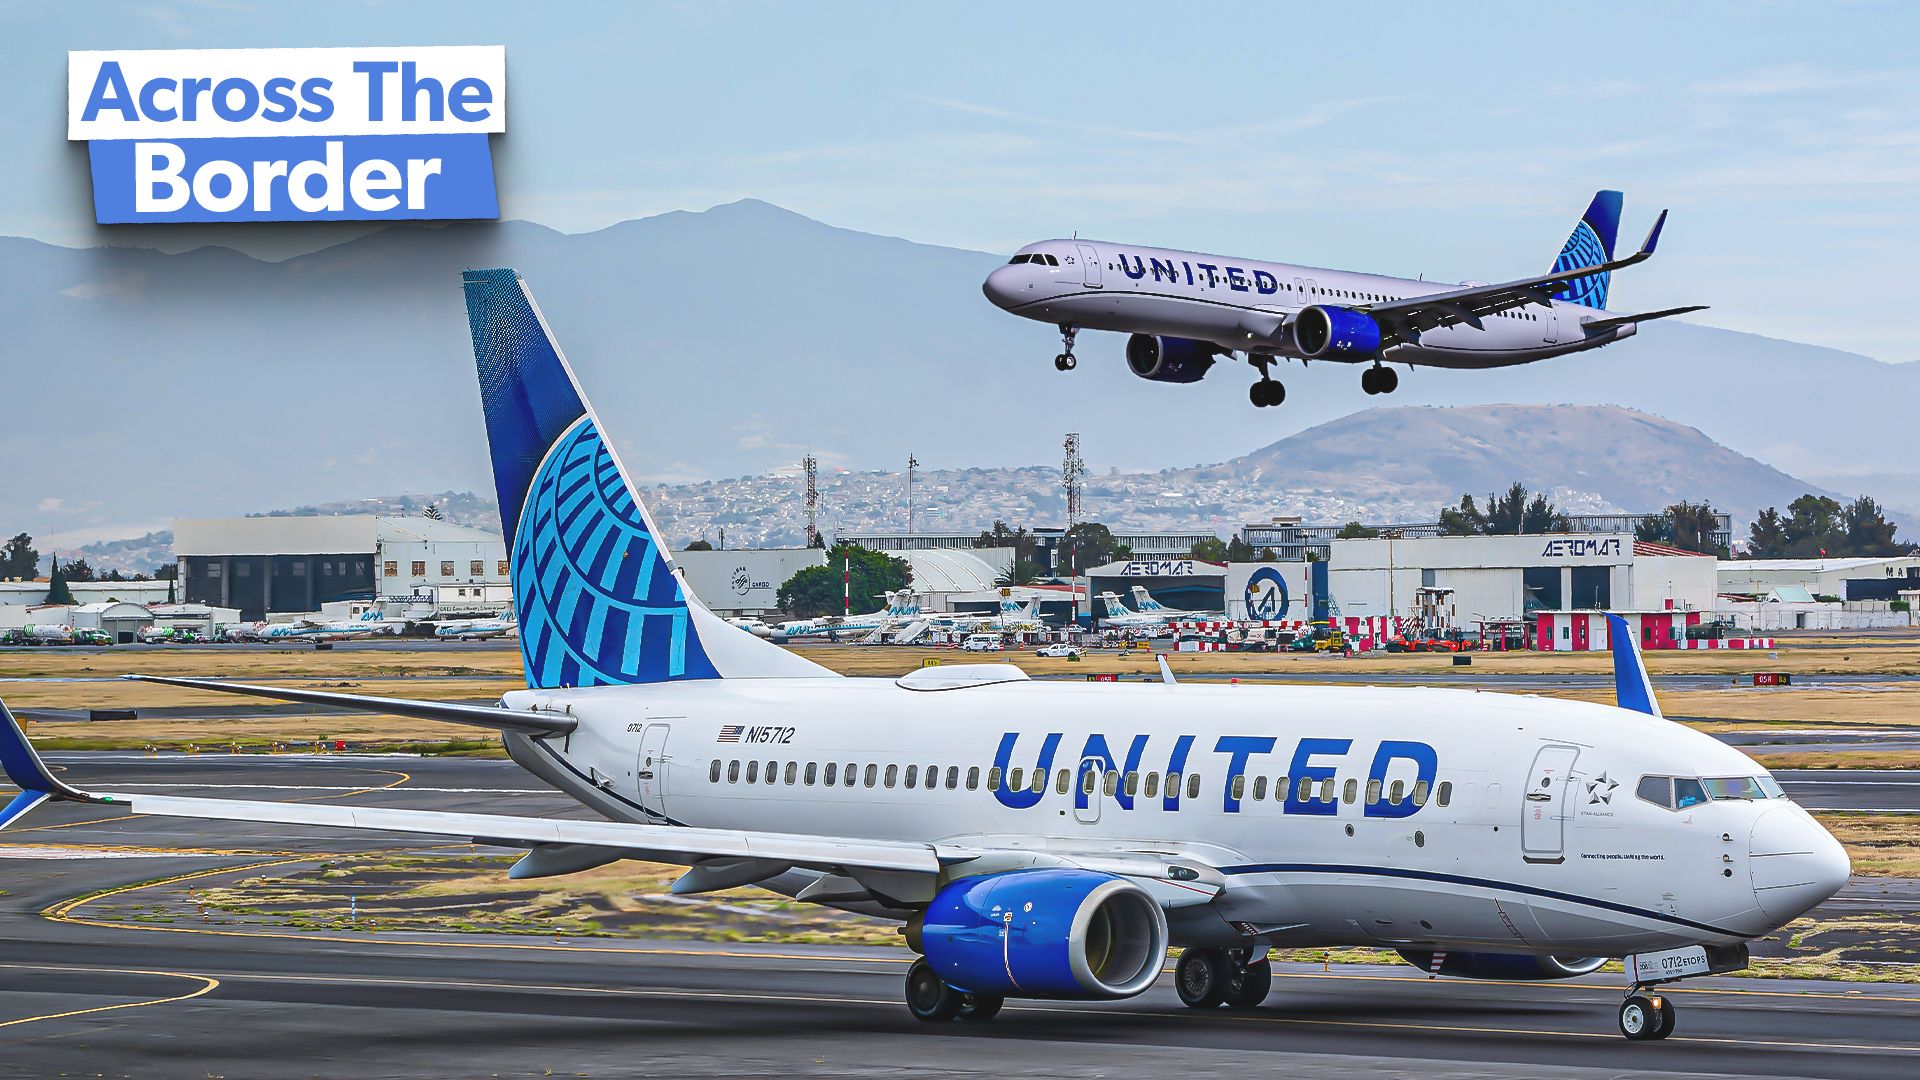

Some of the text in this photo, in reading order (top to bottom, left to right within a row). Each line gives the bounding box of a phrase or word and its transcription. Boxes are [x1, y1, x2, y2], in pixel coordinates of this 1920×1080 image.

[1118, 253, 1279, 295] UNITED
[1542, 538, 1620, 557] AEROMAR
[1120, 561, 1193, 576] AEROMAR
[627, 723, 643, 733] 0712
[745, 725, 796, 744] N15712
[992, 732, 1437, 819] UNITED
[1662, 955, 1705, 969] 0712 ETOPS
